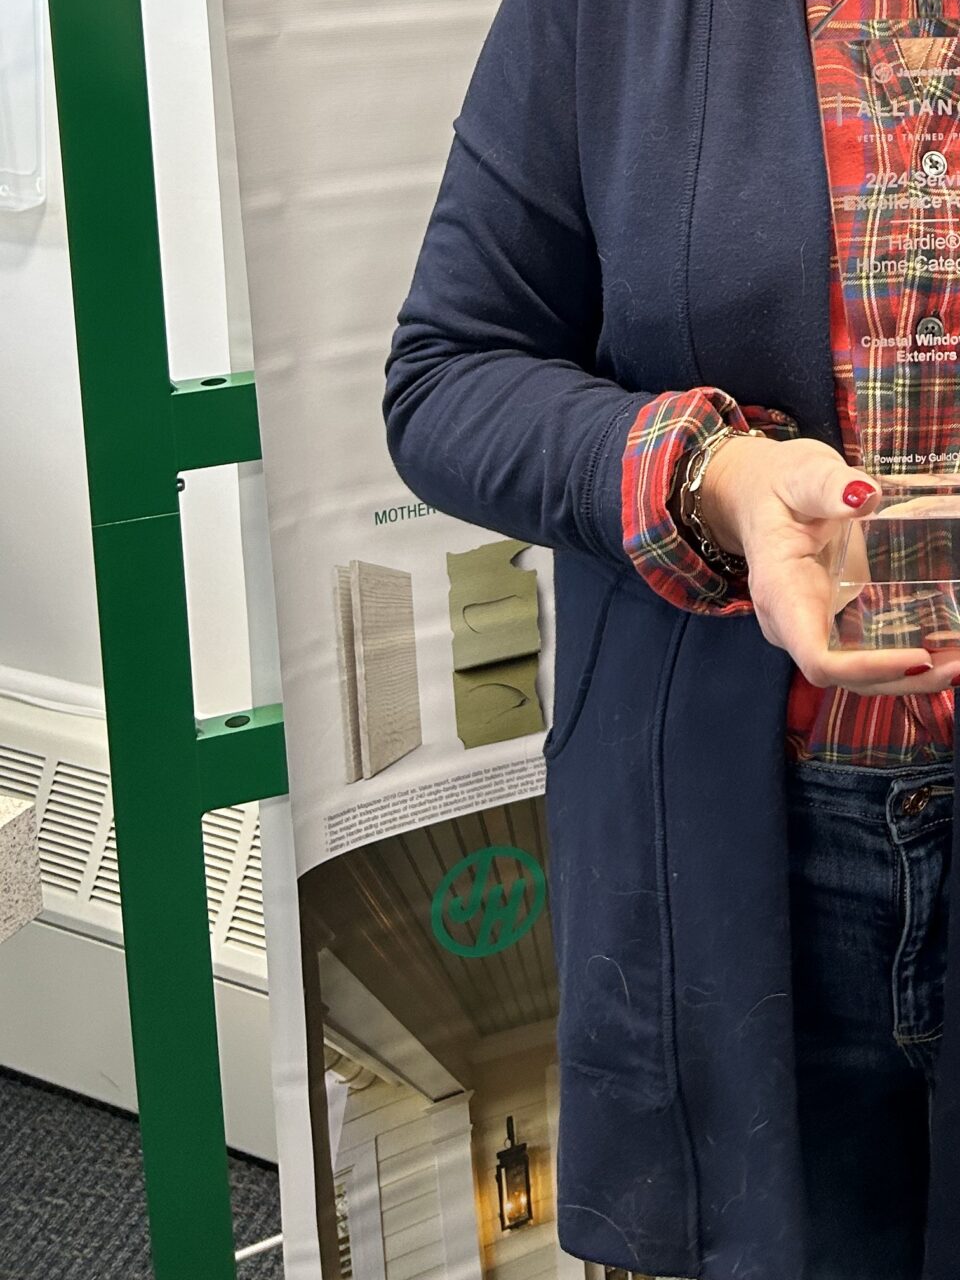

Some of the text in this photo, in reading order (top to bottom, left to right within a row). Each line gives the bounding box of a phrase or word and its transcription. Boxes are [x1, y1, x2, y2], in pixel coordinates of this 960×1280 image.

[866, 172, 909, 188] 2024
[856, 257, 908, 273] Home
[861, 335, 912, 348] Coastal
[896, 349, 958, 362] Exteriors
[873, 453, 913, 464] Powered
[915, 454, 926, 465] by
